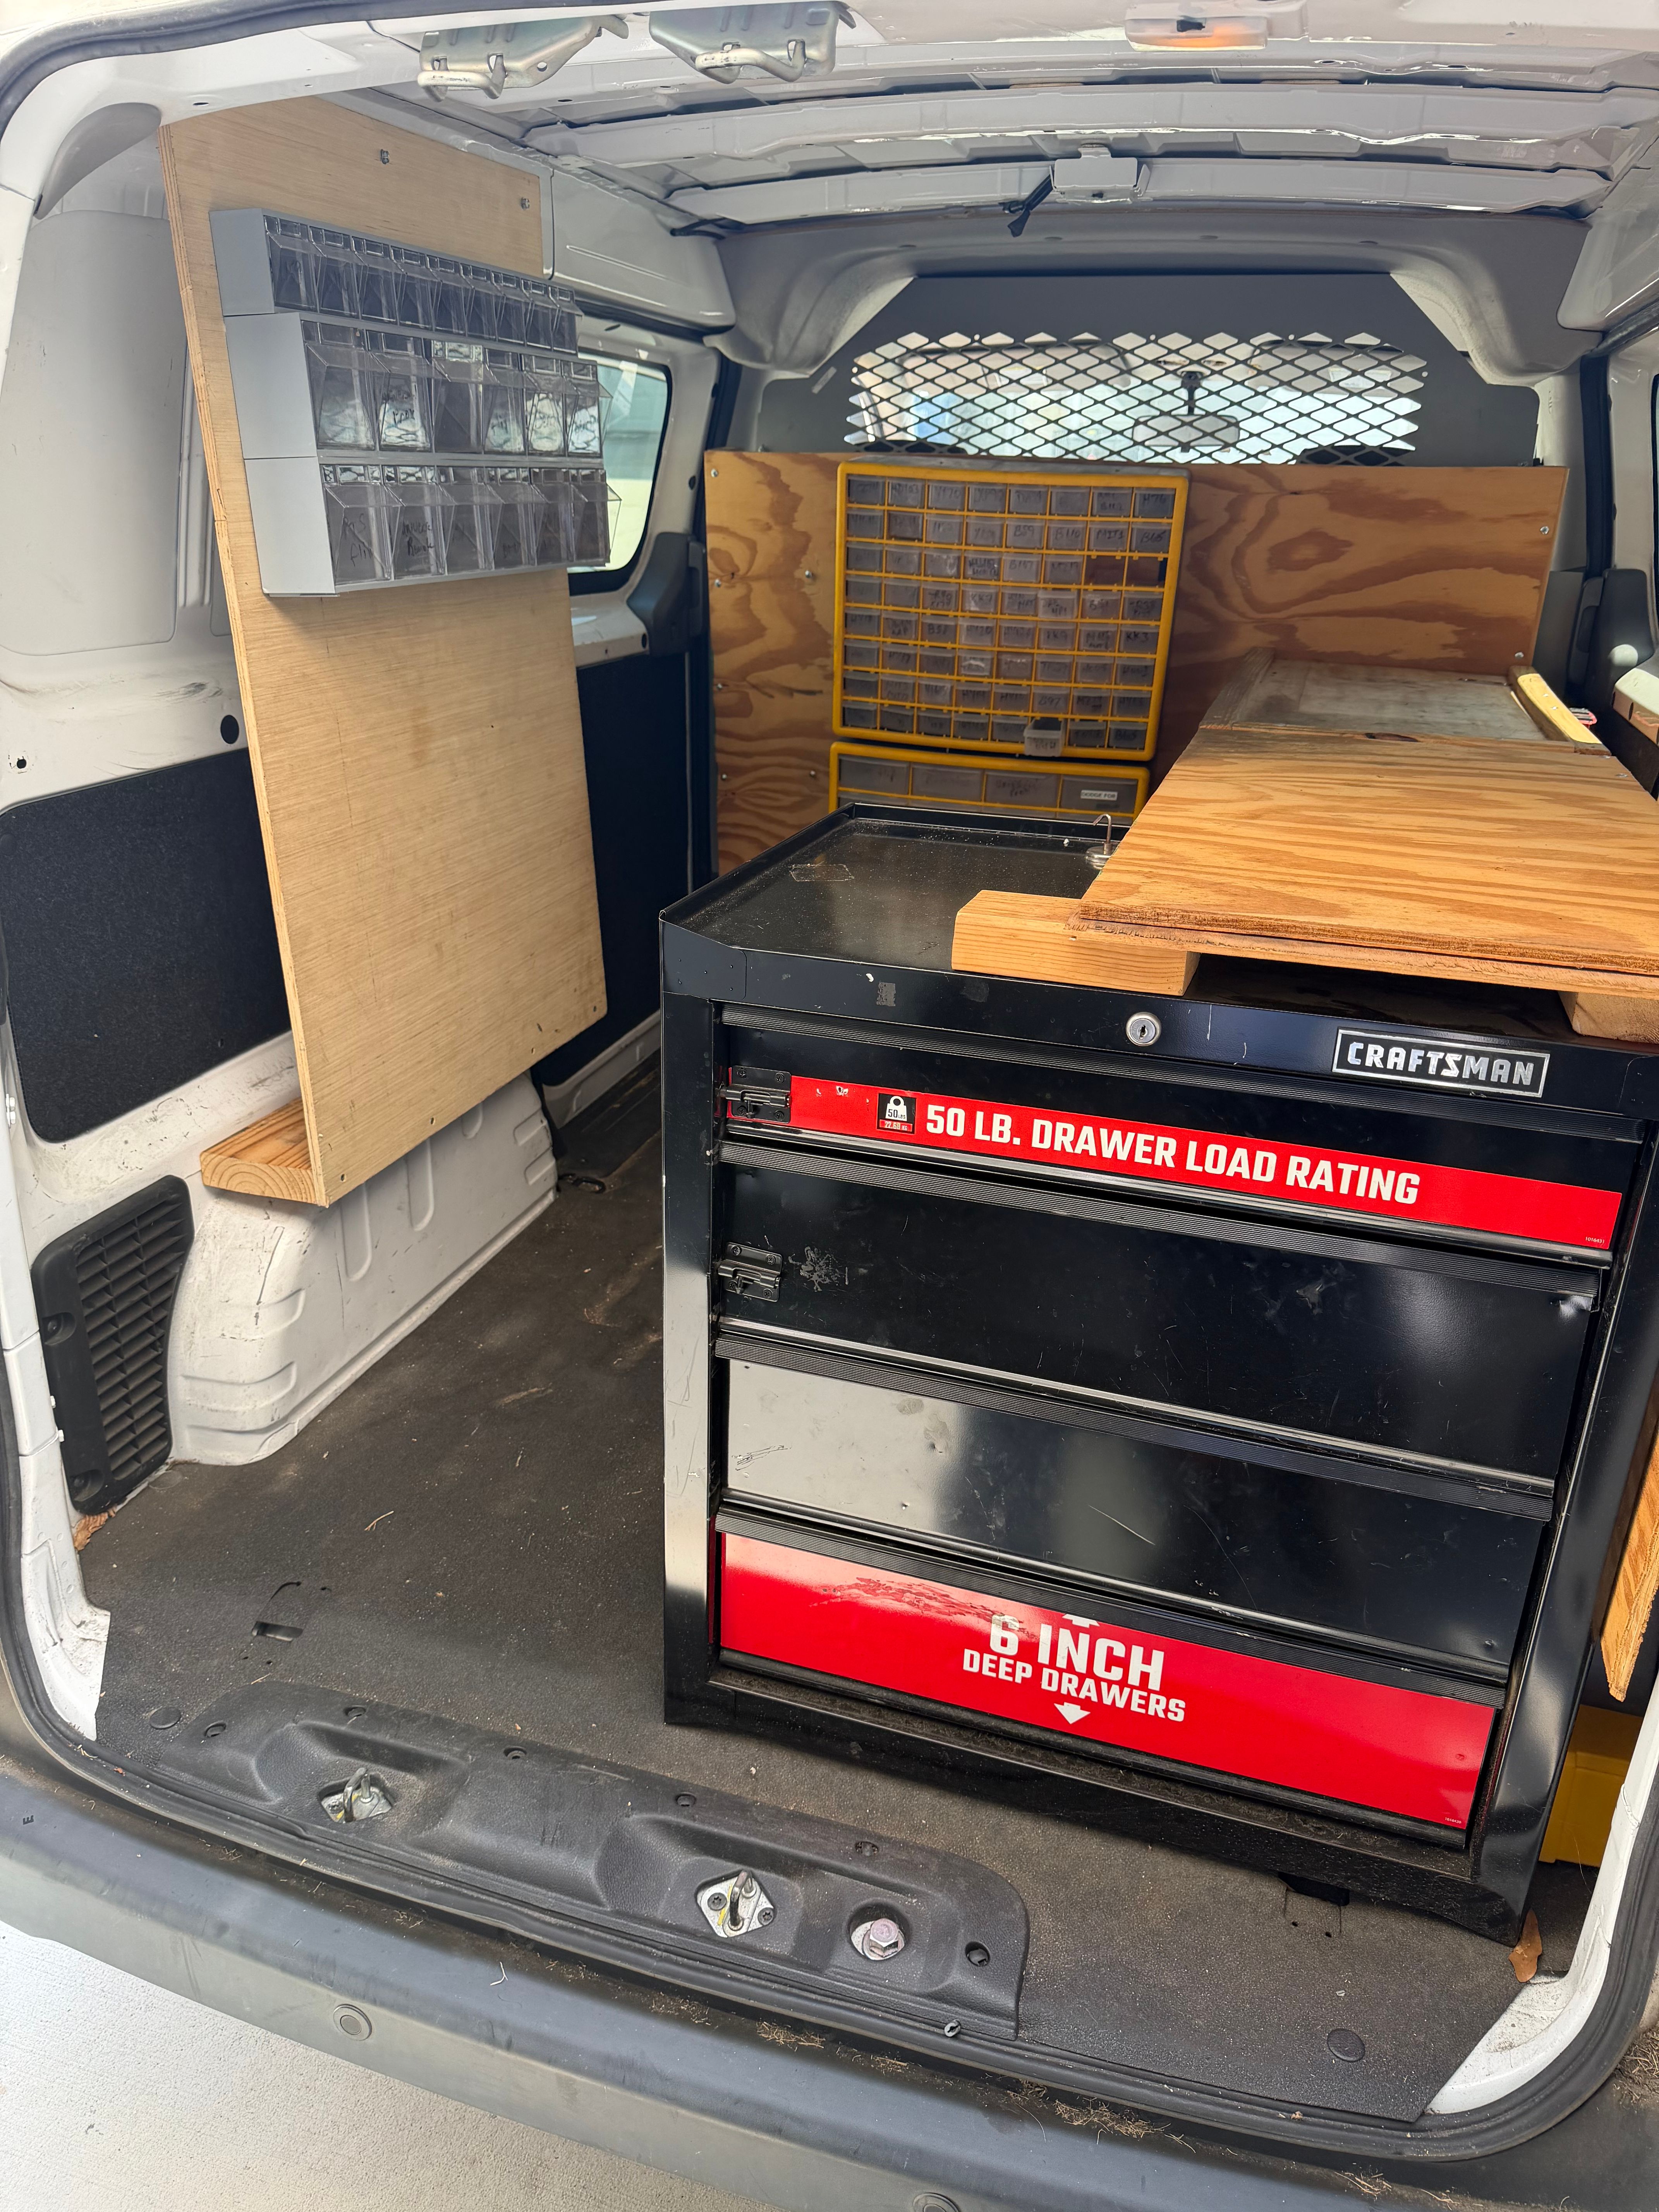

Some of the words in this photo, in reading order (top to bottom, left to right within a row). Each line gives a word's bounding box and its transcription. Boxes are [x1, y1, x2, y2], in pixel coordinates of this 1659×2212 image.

[1346, 1042, 1535, 1086] CRAFTSMAN
[888, 1109, 898, 1118] 50
[926, 1104, 965, 1137] 50
[974, 1111, 1021, 1145] LB.
[1032, 1119, 1176, 1168] DRAWER
[1185, 1140, 1275, 1183] LOAD
[1286, 1156, 1420, 1205] RATING
[963, 1648, 1033, 1684] DEEP
[1041, 1668, 1186, 1723] DRAWERS
[989, 1613, 1020, 1656] 6
[1037, 1623, 1164, 1692] INCH
